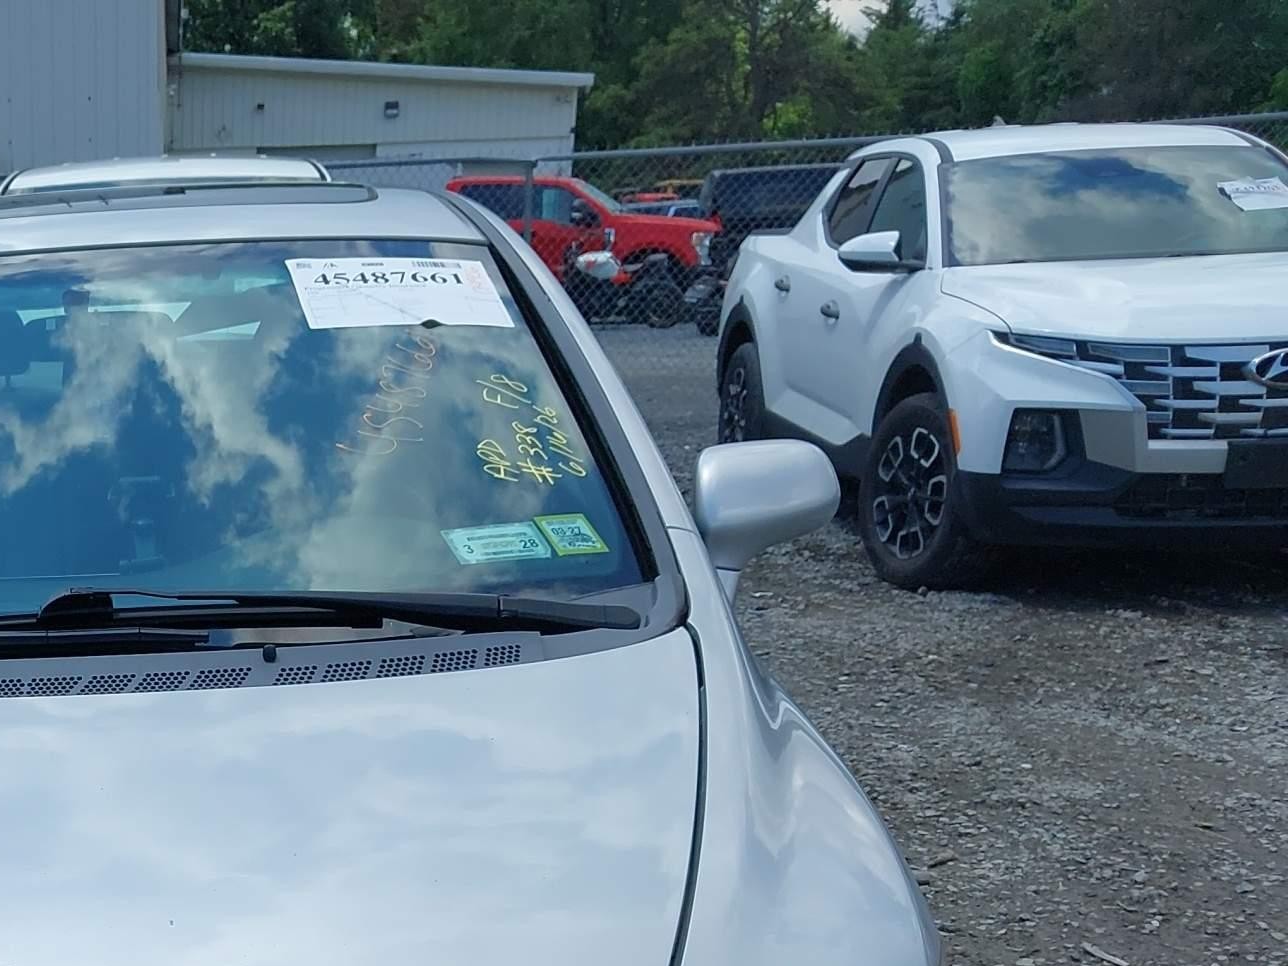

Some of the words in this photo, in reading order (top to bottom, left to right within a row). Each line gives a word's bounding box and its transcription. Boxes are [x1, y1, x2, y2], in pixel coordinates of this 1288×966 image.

[314, 271, 463, 285] 45487661
[463, 544, 474, 554] 3
[519, 538, 539, 549] 28
